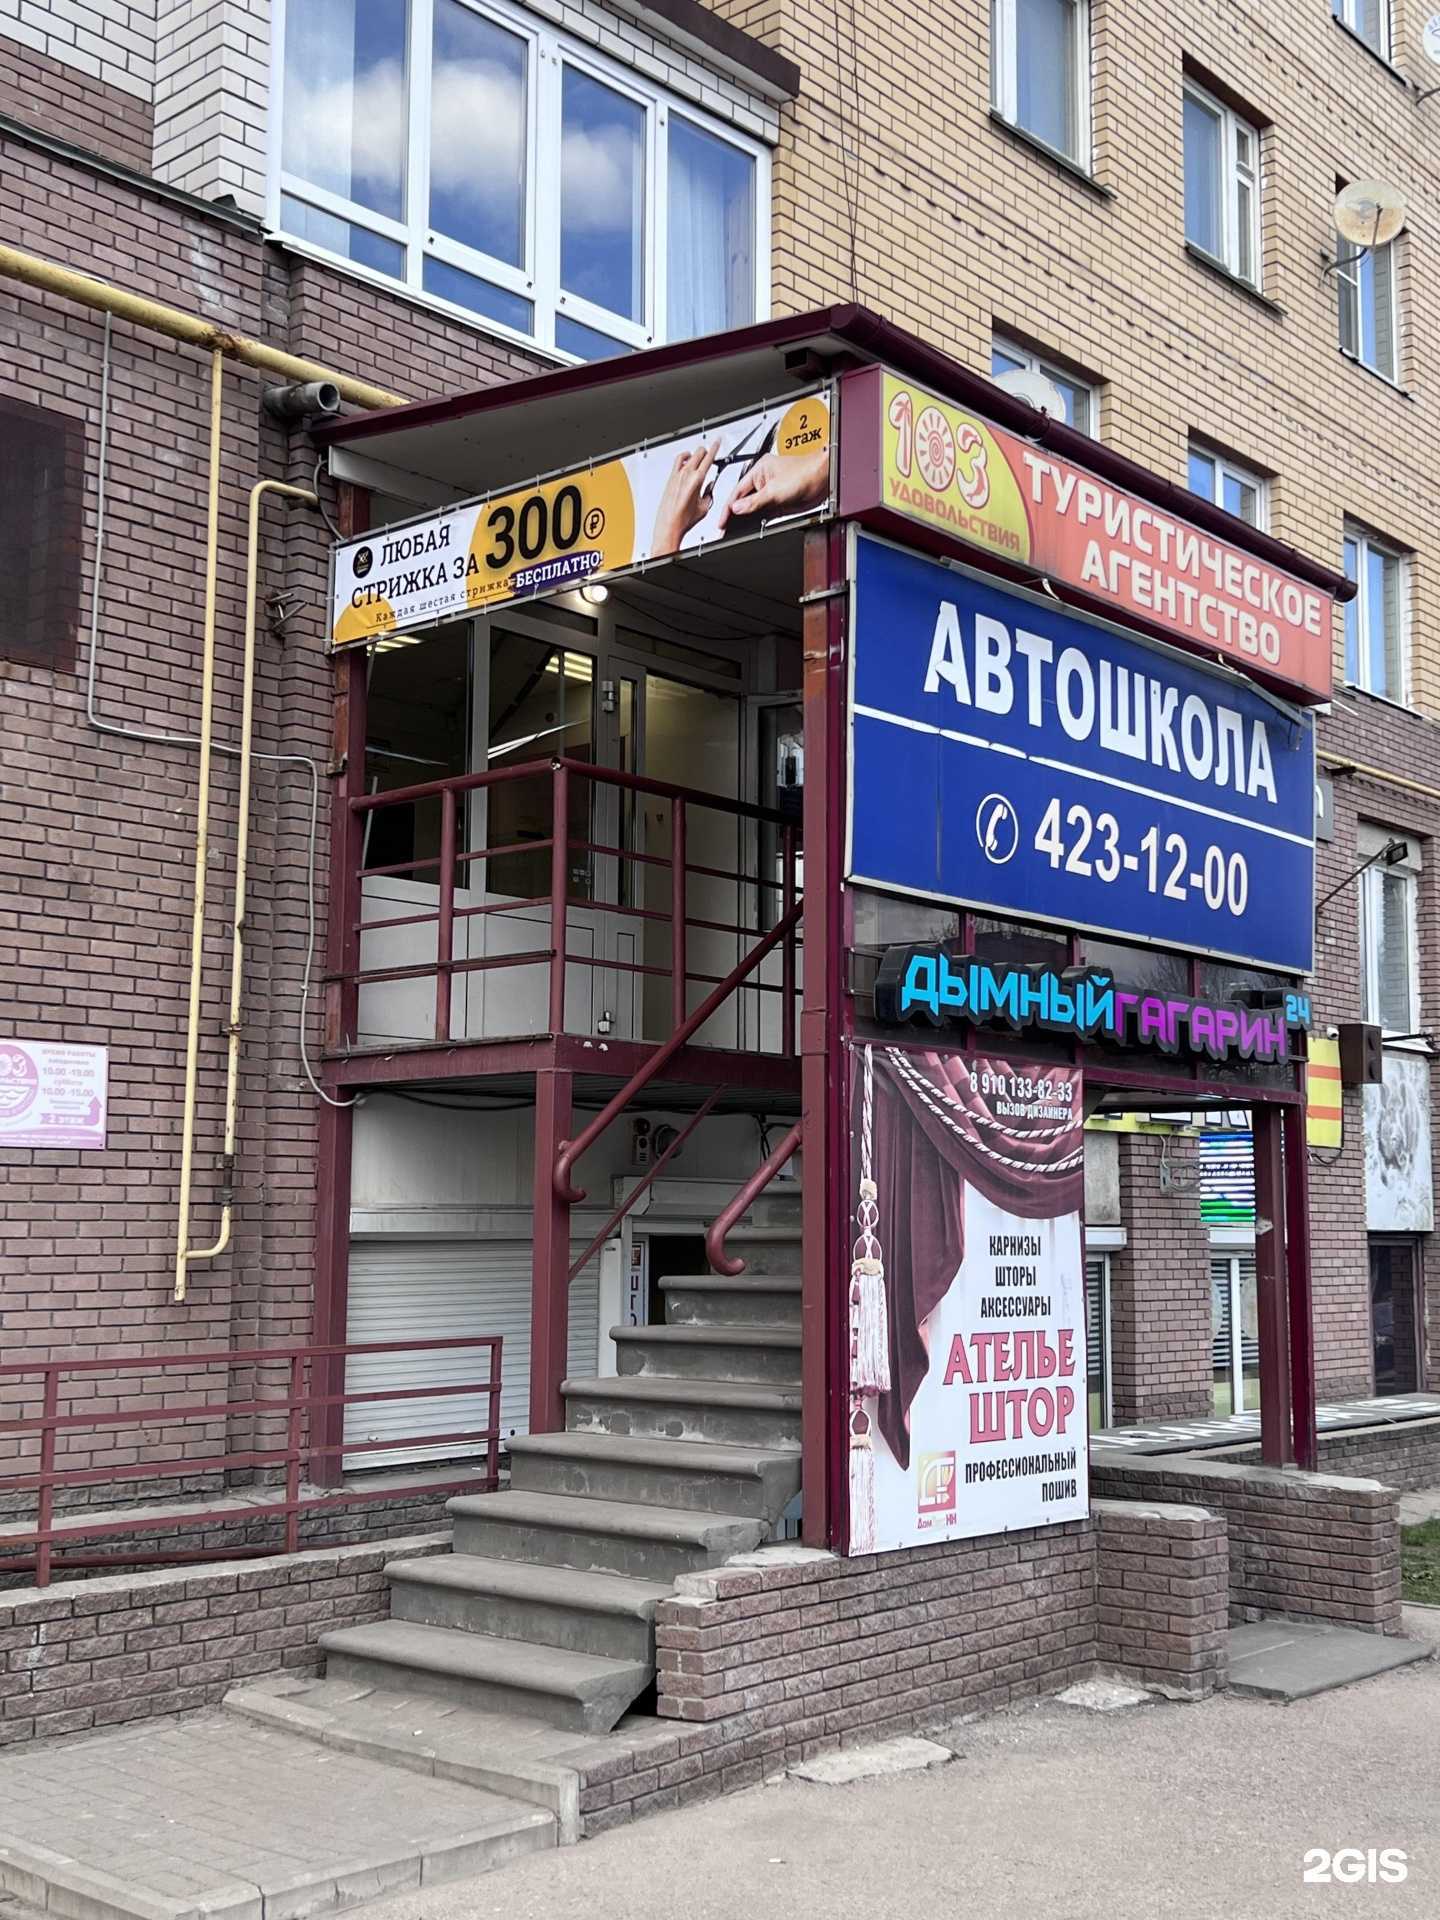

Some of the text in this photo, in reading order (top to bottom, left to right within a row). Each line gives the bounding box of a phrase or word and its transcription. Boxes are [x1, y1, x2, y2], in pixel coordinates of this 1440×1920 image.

[785, 428, 822, 449] этаж
[799, 414, 808, 430] 2
[888, 390, 990, 509] 103
[486, 485, 582, 569] 300
[889, 477, 1020, 553] УДОВОЛЬСТВИЯ
[380, 524, 450, 567] ЛЮБАЯ
[1023, 451, 1321, 637] ТУРИСТИЧЕСКОЕ
[351, 552, 480, 609] СТРИЖКА ЗА
[376, 606, 416, 623] Каждая
[419, 593, 456, 611] шестая
[460, 577, 509, 599] стрижка
[1080, 543, 1281, 666] АГЕНТСТВО
[924, 600, 1278, 804] АВТОШКОЛА
[1034, 798, 1248, 917] 423-12-00
[1114, 991, 1286, 1057] ГАГАРИН
[1285, 993, 1310, 1025] 24
[970, 1072, 1073, 1102] 8 910 133-82-33
[996, 1100, 1026, 1117] ВЫЗОВ
[1027, 1102, 1073, 1120] ДИЗАЙНЕРА
[989, 1235, 1041, 1257] КАРНИЗЫ
[995, 1266, 1037, 1287] ШТОРЫ
[980, 1296, 1051, 1319] АКСЕССУАРЫ
[942, 1328, 1076, 1386] АТЕЛЬЕ
[969, 1385, 1075, 1444] ШТОР
[965, 1446, 1077, 1484] ПРОФЕССИОНАЛЬНЫЙ
[1042, 1479, 1077, 1503] ПОШИВ
